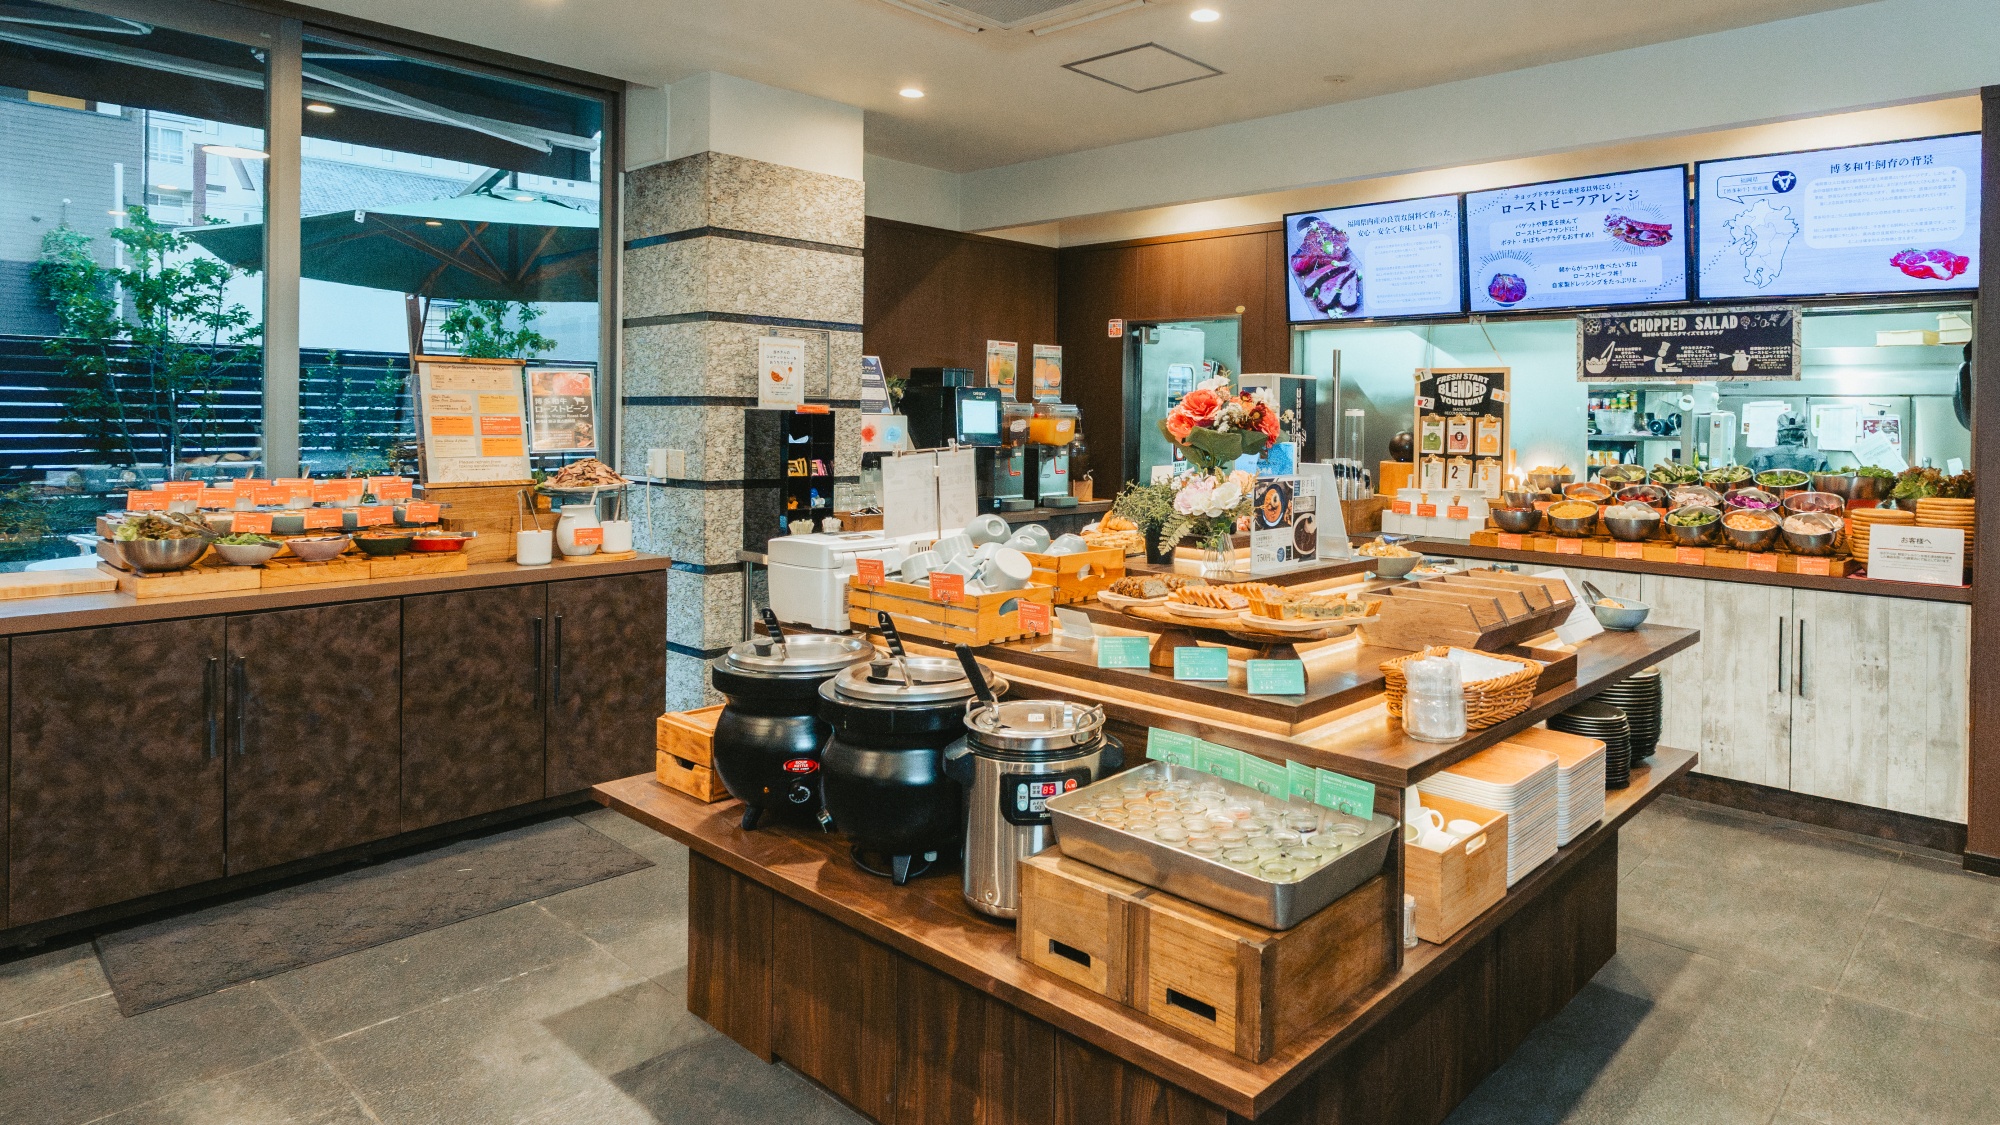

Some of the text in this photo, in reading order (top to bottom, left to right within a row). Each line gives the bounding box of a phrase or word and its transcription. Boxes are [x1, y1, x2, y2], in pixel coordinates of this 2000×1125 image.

[1830, 154, 1934, 174] 博多和牛飼育の背景
[1501, 189, 1640, 214] ローストビーフアレンジ
[1558, 261, 1638, 273] 朝からがっつり食べたい方は
[1629, 315, 1738, 333] CHOPPED SALAD
[1421, 371, 1425, 379] 1
[1436, 373, 1490, 385] FRESH START
[1438, 380, 1487, 399] BLENDED
[534, 397, 568, 405] 博多和牛
[1439, 395, 1484, 407] YOUR WAY
[1501, 393, 1506, 401] 3
[535, 405, 589, 413] ローストビーフ
[1424, 399, 1429, 408] 2
[1424, 464, 1429, 478] 1
[1451, 465, 1458, 480] 2
[1481, 467, 1489, 481] 3
[1900, 537, 1932, 545] お客様へ
[1042, 786, 1055, 795] 85
